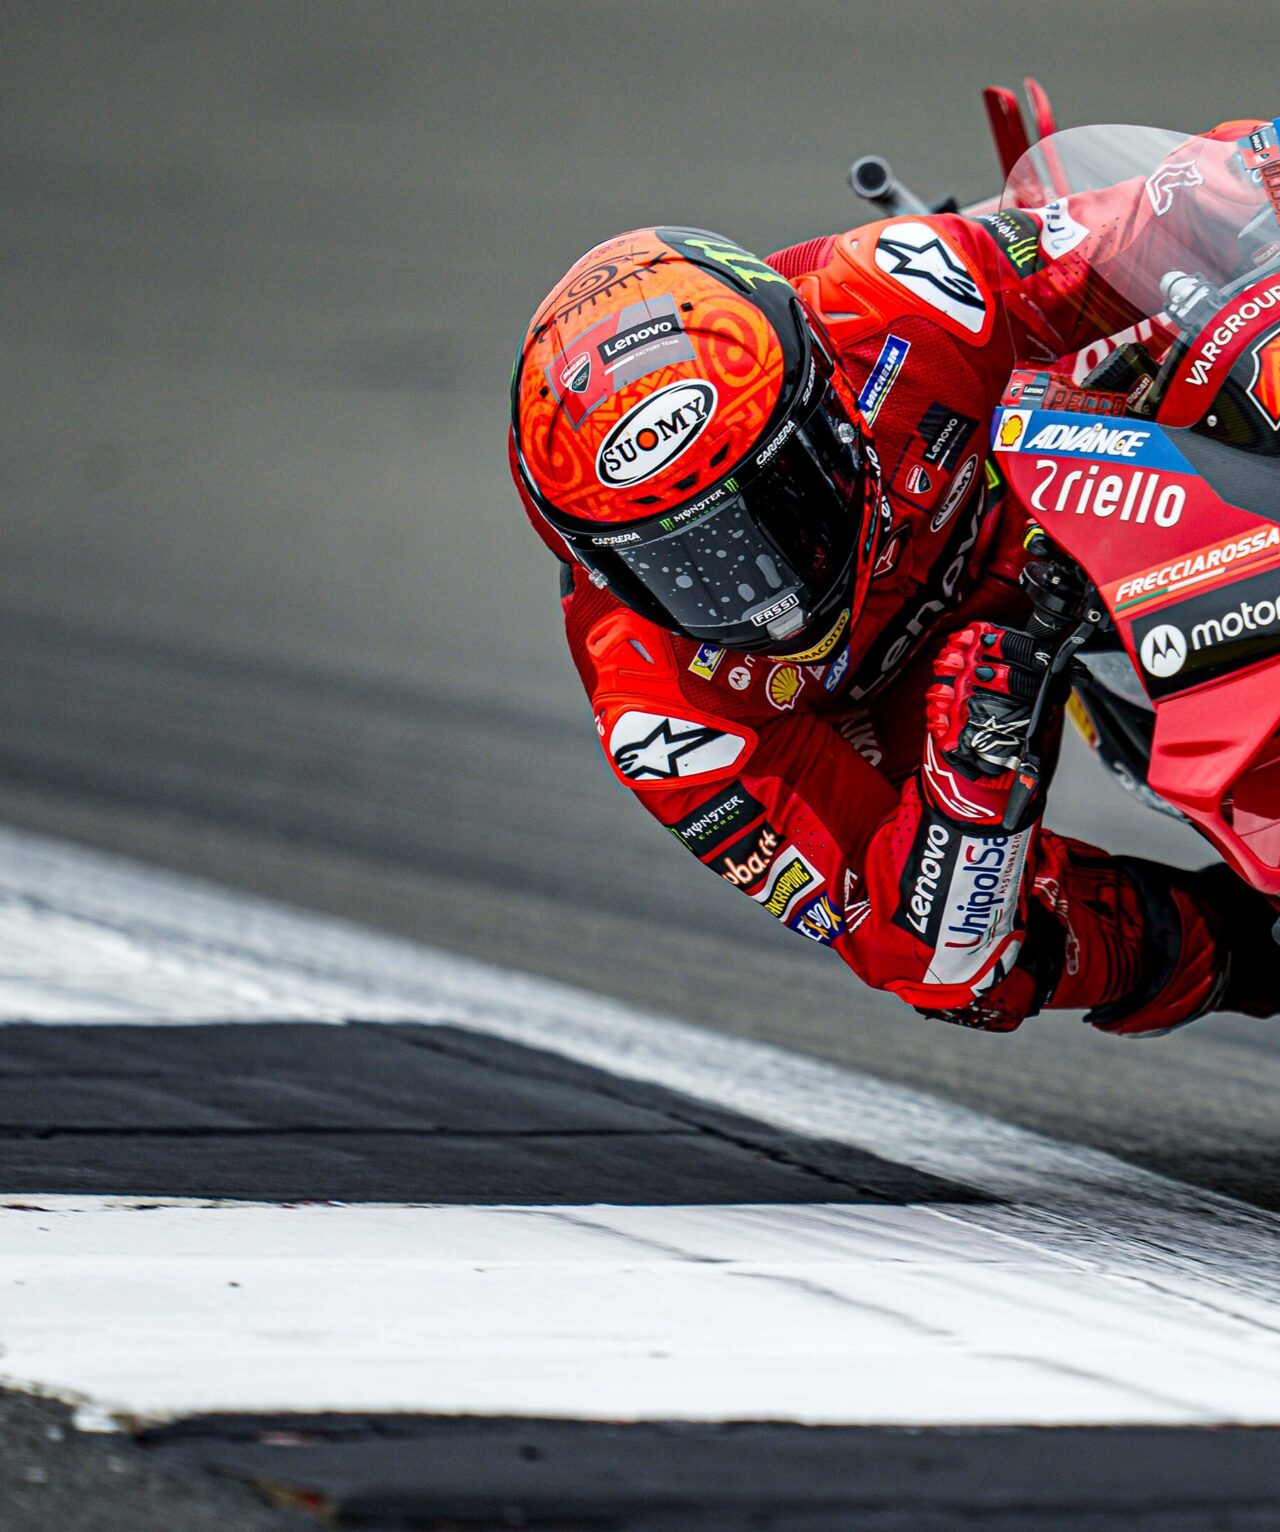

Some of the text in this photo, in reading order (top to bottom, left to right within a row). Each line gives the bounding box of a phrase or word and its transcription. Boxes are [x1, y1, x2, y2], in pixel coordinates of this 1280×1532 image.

[603, 321, 673, 358] Lenovo
[865, 346, 900, 409] MICHELIN
[602, 396, 707, 473] SUOMY
[756, 419, 797, 467] CARRERA
[925, 417, 959, 460] Lenovo
[1025, 423, 1151, 457] ADVANCE
[673, 487, 726, 523] MONSTER
[591, 531, 641, 546] CARRERA
[1114, 527, 1280, 603] FRECCIAROSSA
[755, 597, 795, 624] FASSI
[825, 649, 849, 692] SAP
[681, 795, 745, 839] MONSTER
[697, 809, 741, 841] ENERGY
[722, 828, 778, 885] uba.it
[998, 832, 1024, 895] ASSICURAZIO
[906, 823, 950, 935] Lenovo
[944, 834, 1009, 949] UnipolSa
